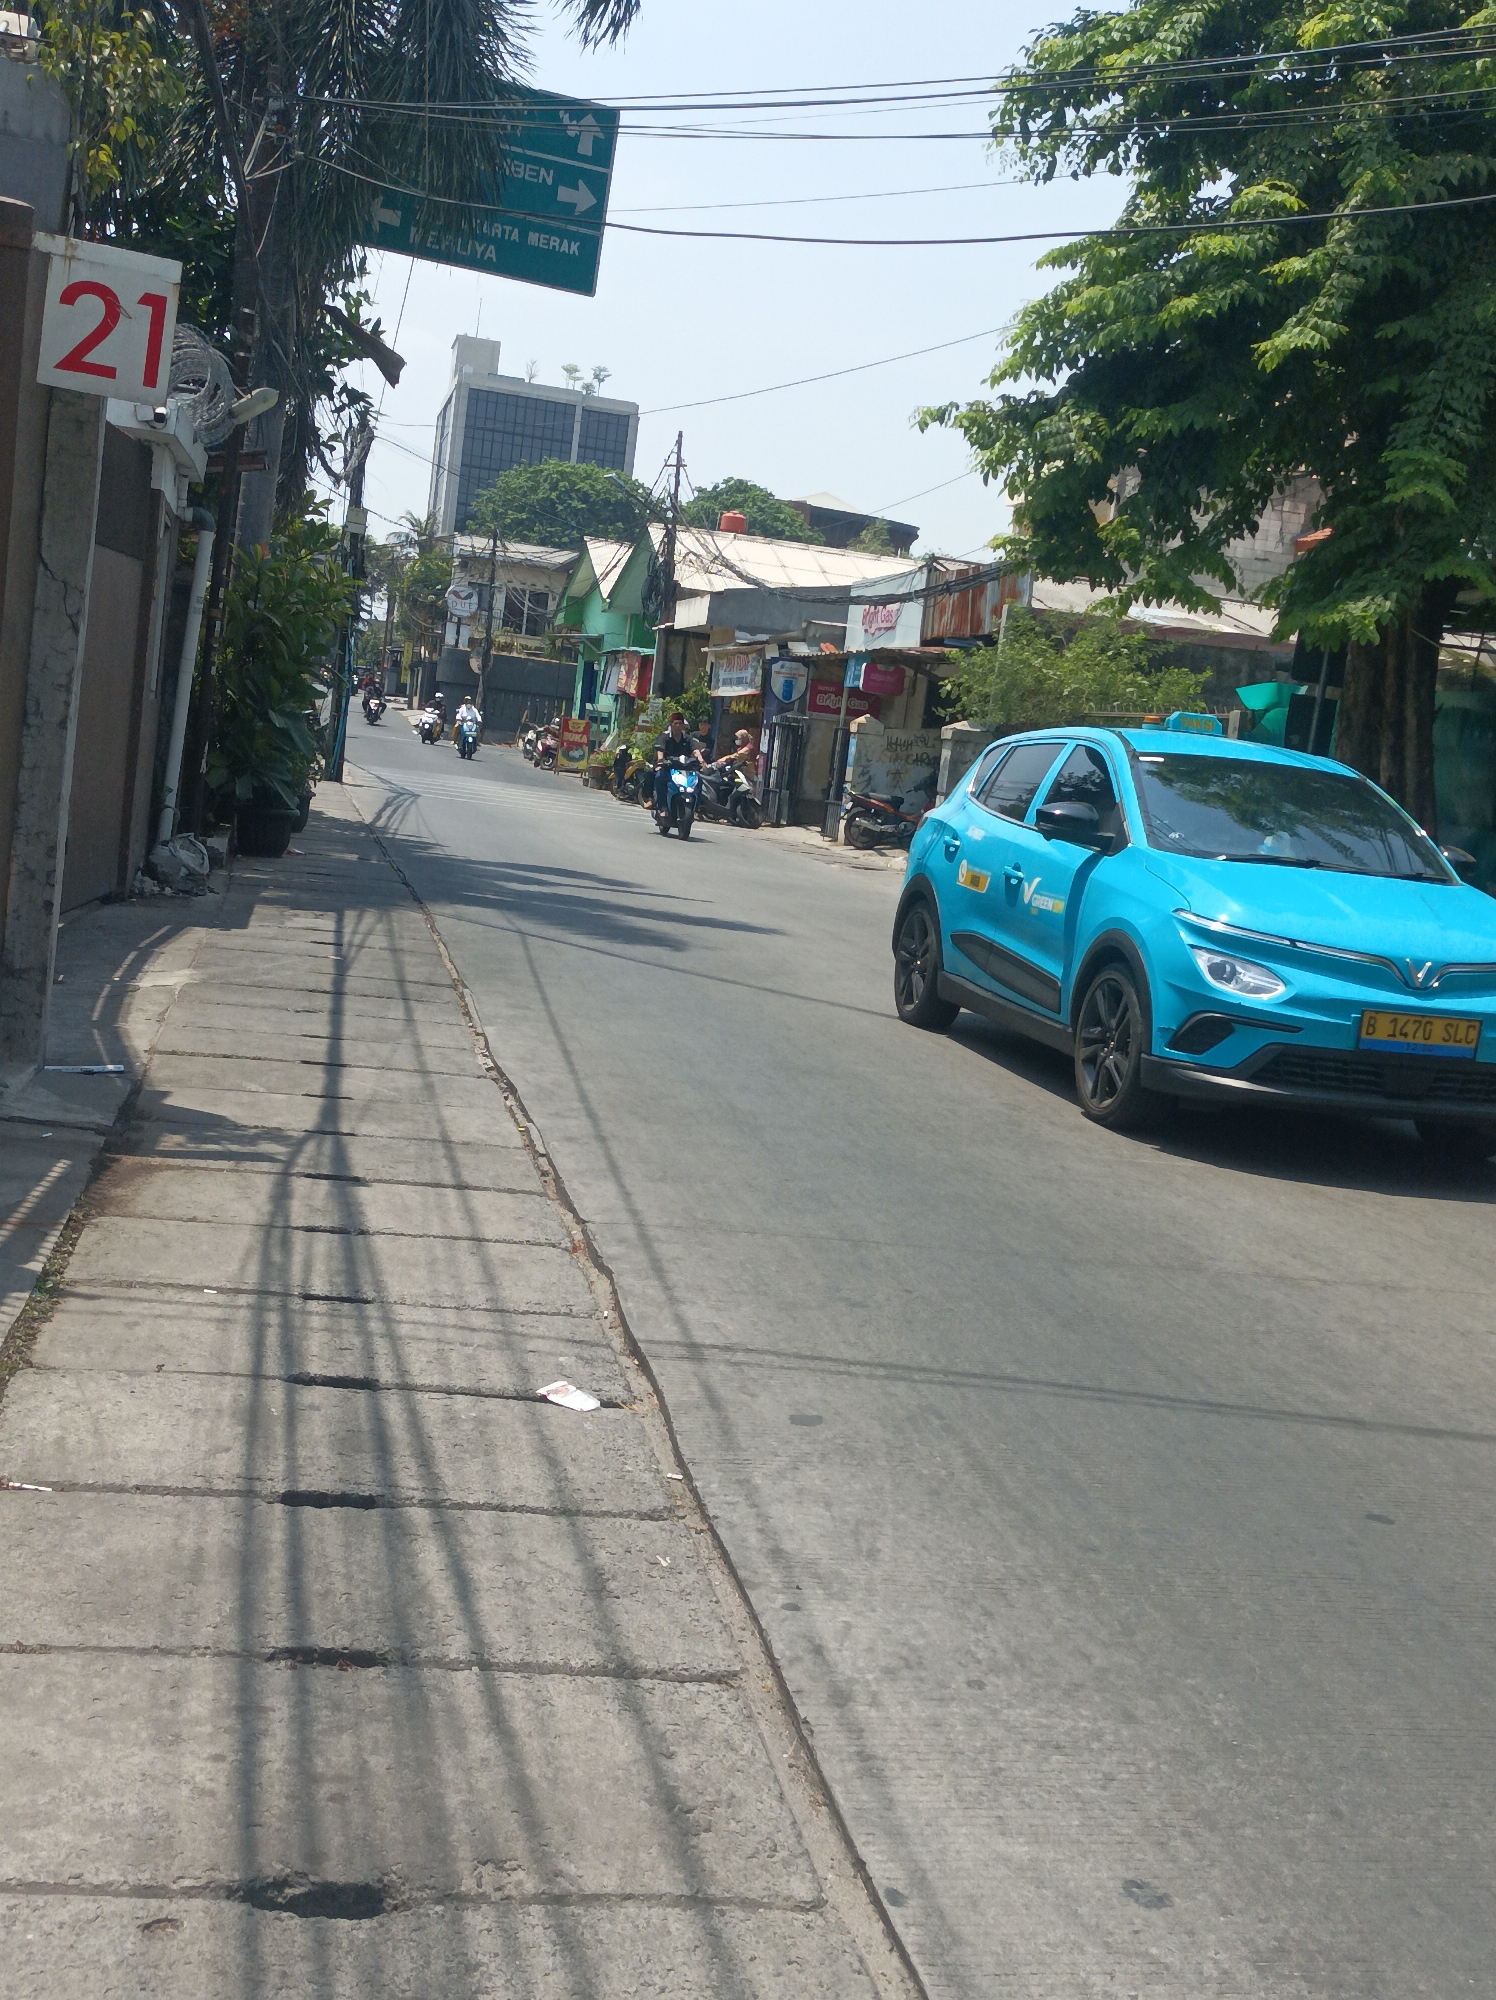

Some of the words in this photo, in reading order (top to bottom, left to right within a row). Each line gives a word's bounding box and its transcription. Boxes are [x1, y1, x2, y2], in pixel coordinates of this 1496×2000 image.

[527, 231, 581, 256] MERAK
[53, 280, 168, 389] 21
[452, 600, 474, 610] DUE
[847, 697, 869, 711] Gas
[1180, 715, 1215, 731] TAKSI
[563, 731, 588, 744] BUKA
[1365, 1015, 1378, 1036] B
[1386, 1017, 1434, 1041] 1470
[1441, 1022, 1478, 1045] SLC
